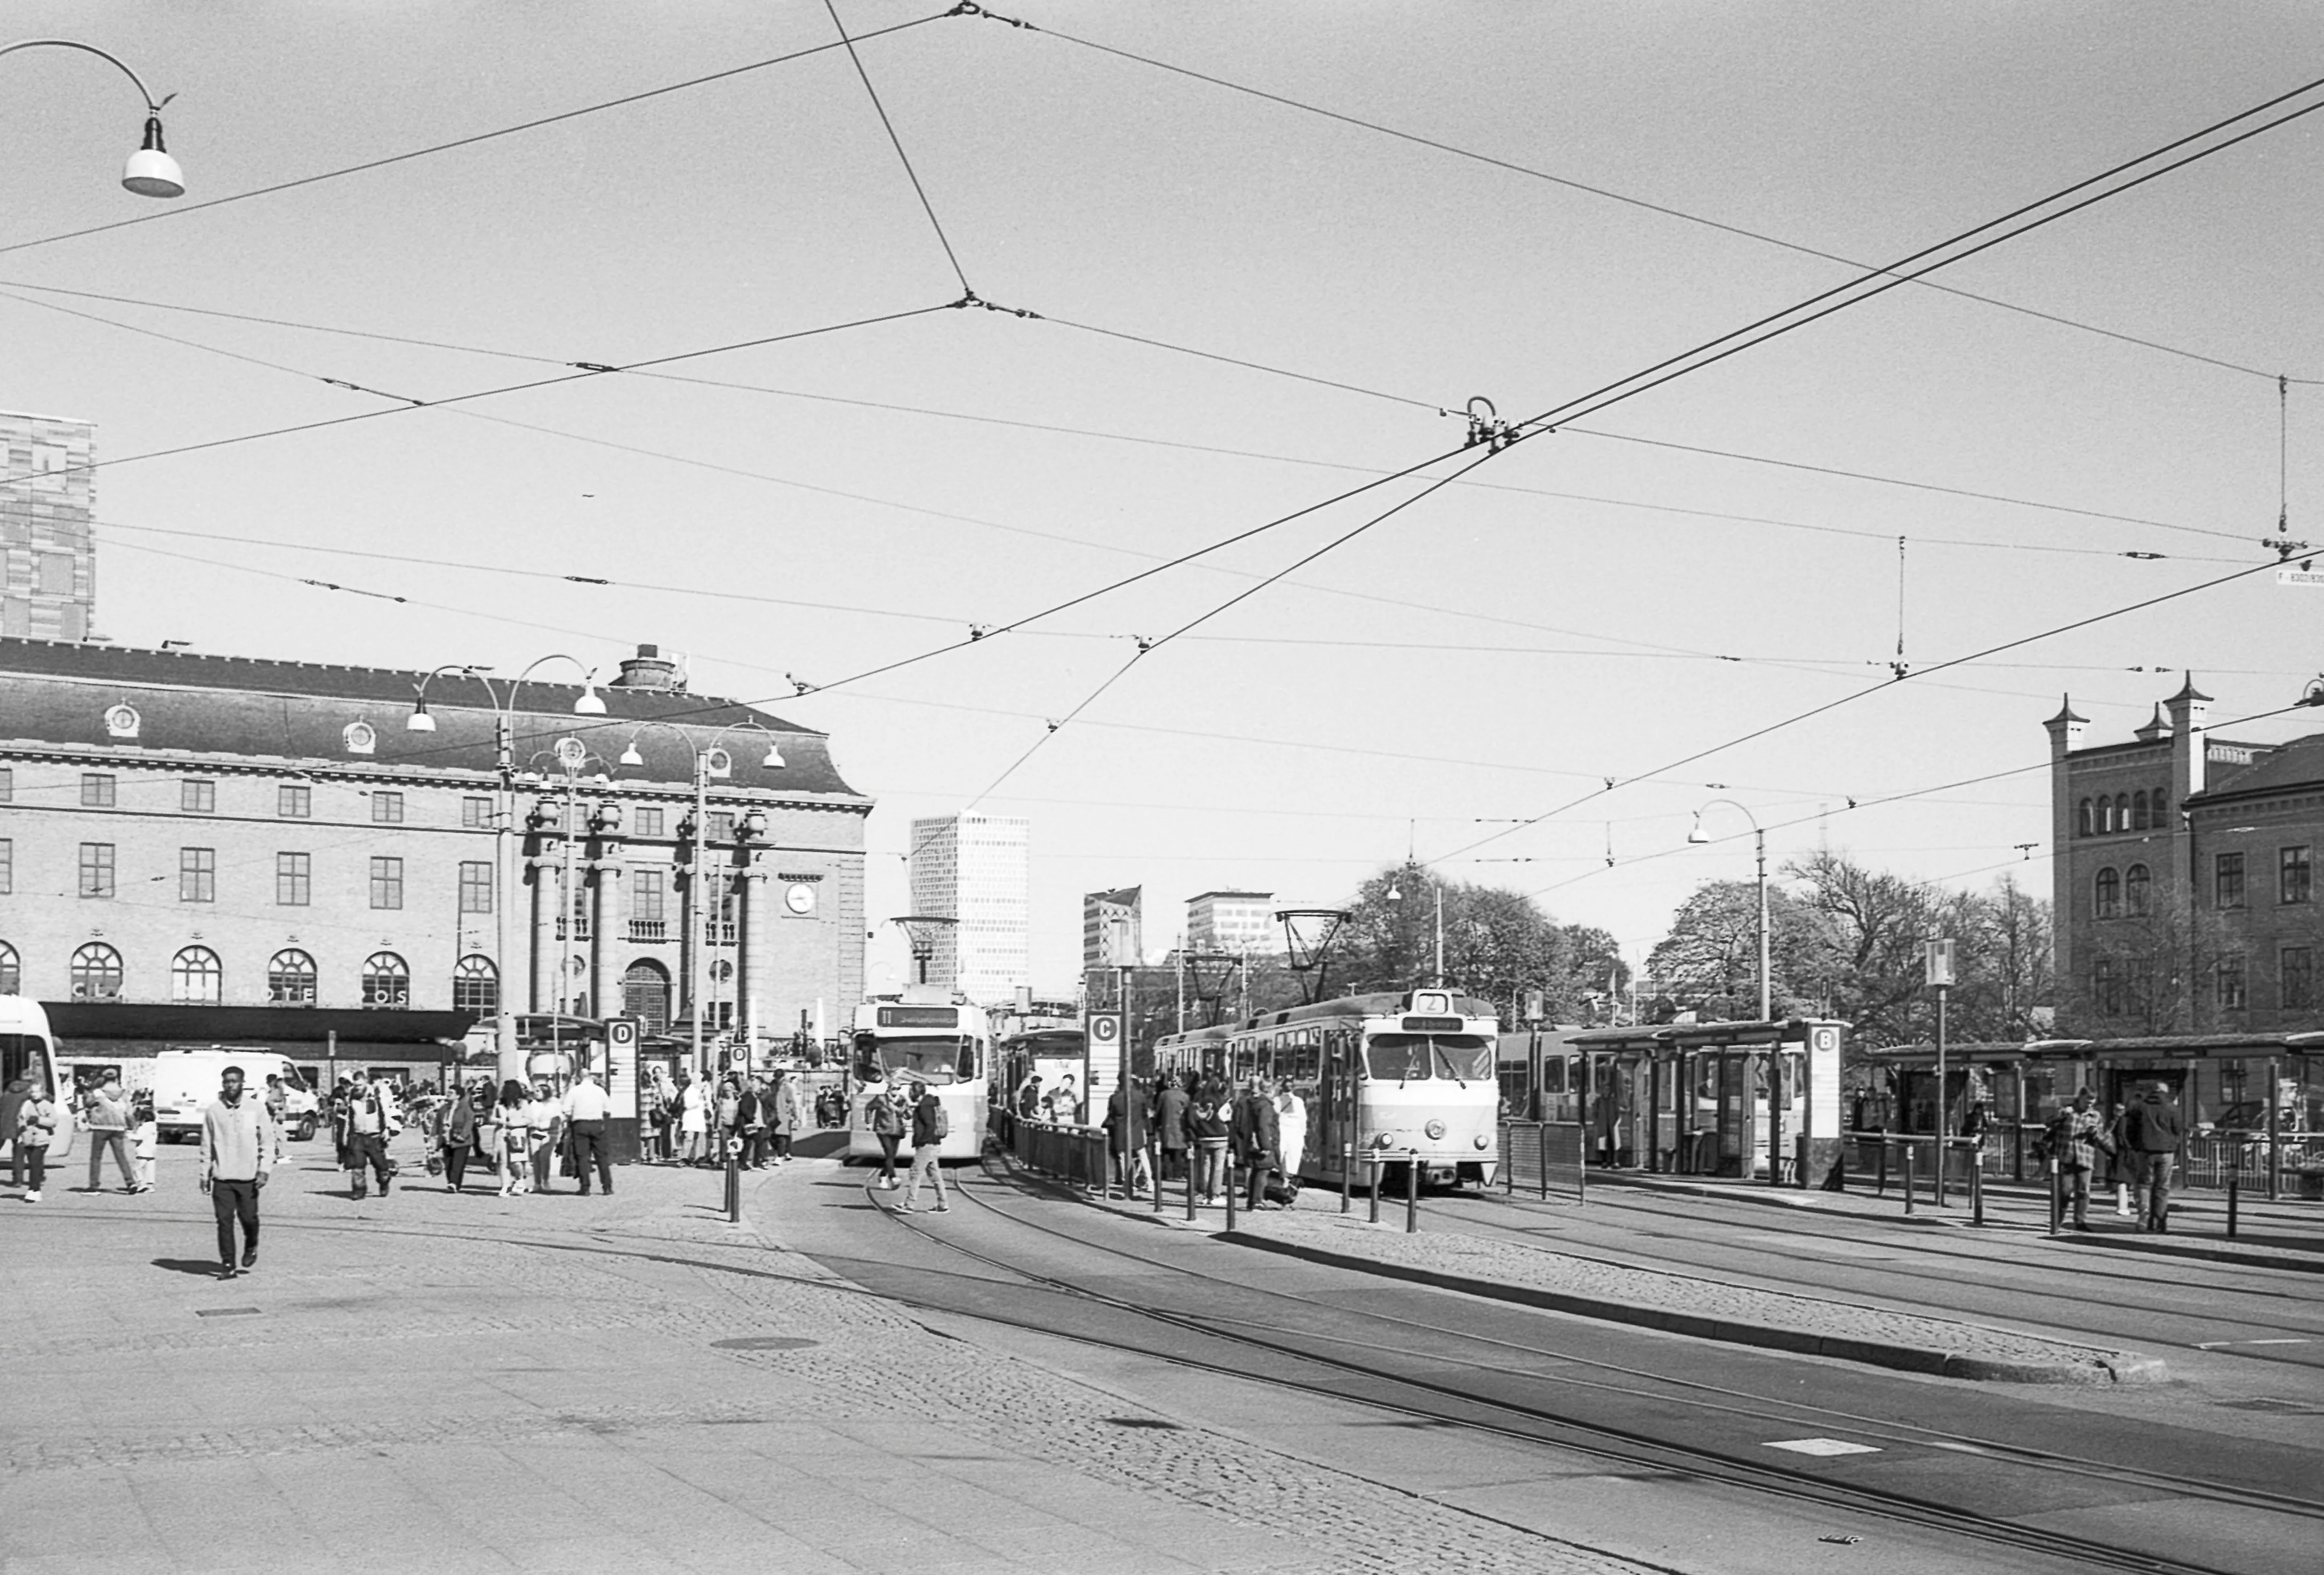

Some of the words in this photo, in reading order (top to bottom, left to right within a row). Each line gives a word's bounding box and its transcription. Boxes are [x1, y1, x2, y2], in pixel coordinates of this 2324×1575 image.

[1426, 996, 1436, 1011] 2
[618, 1026, 628, 1041] D
[1100, 1021, 1111, 1037] C
[1820, 1031, 1832, 1048] B
